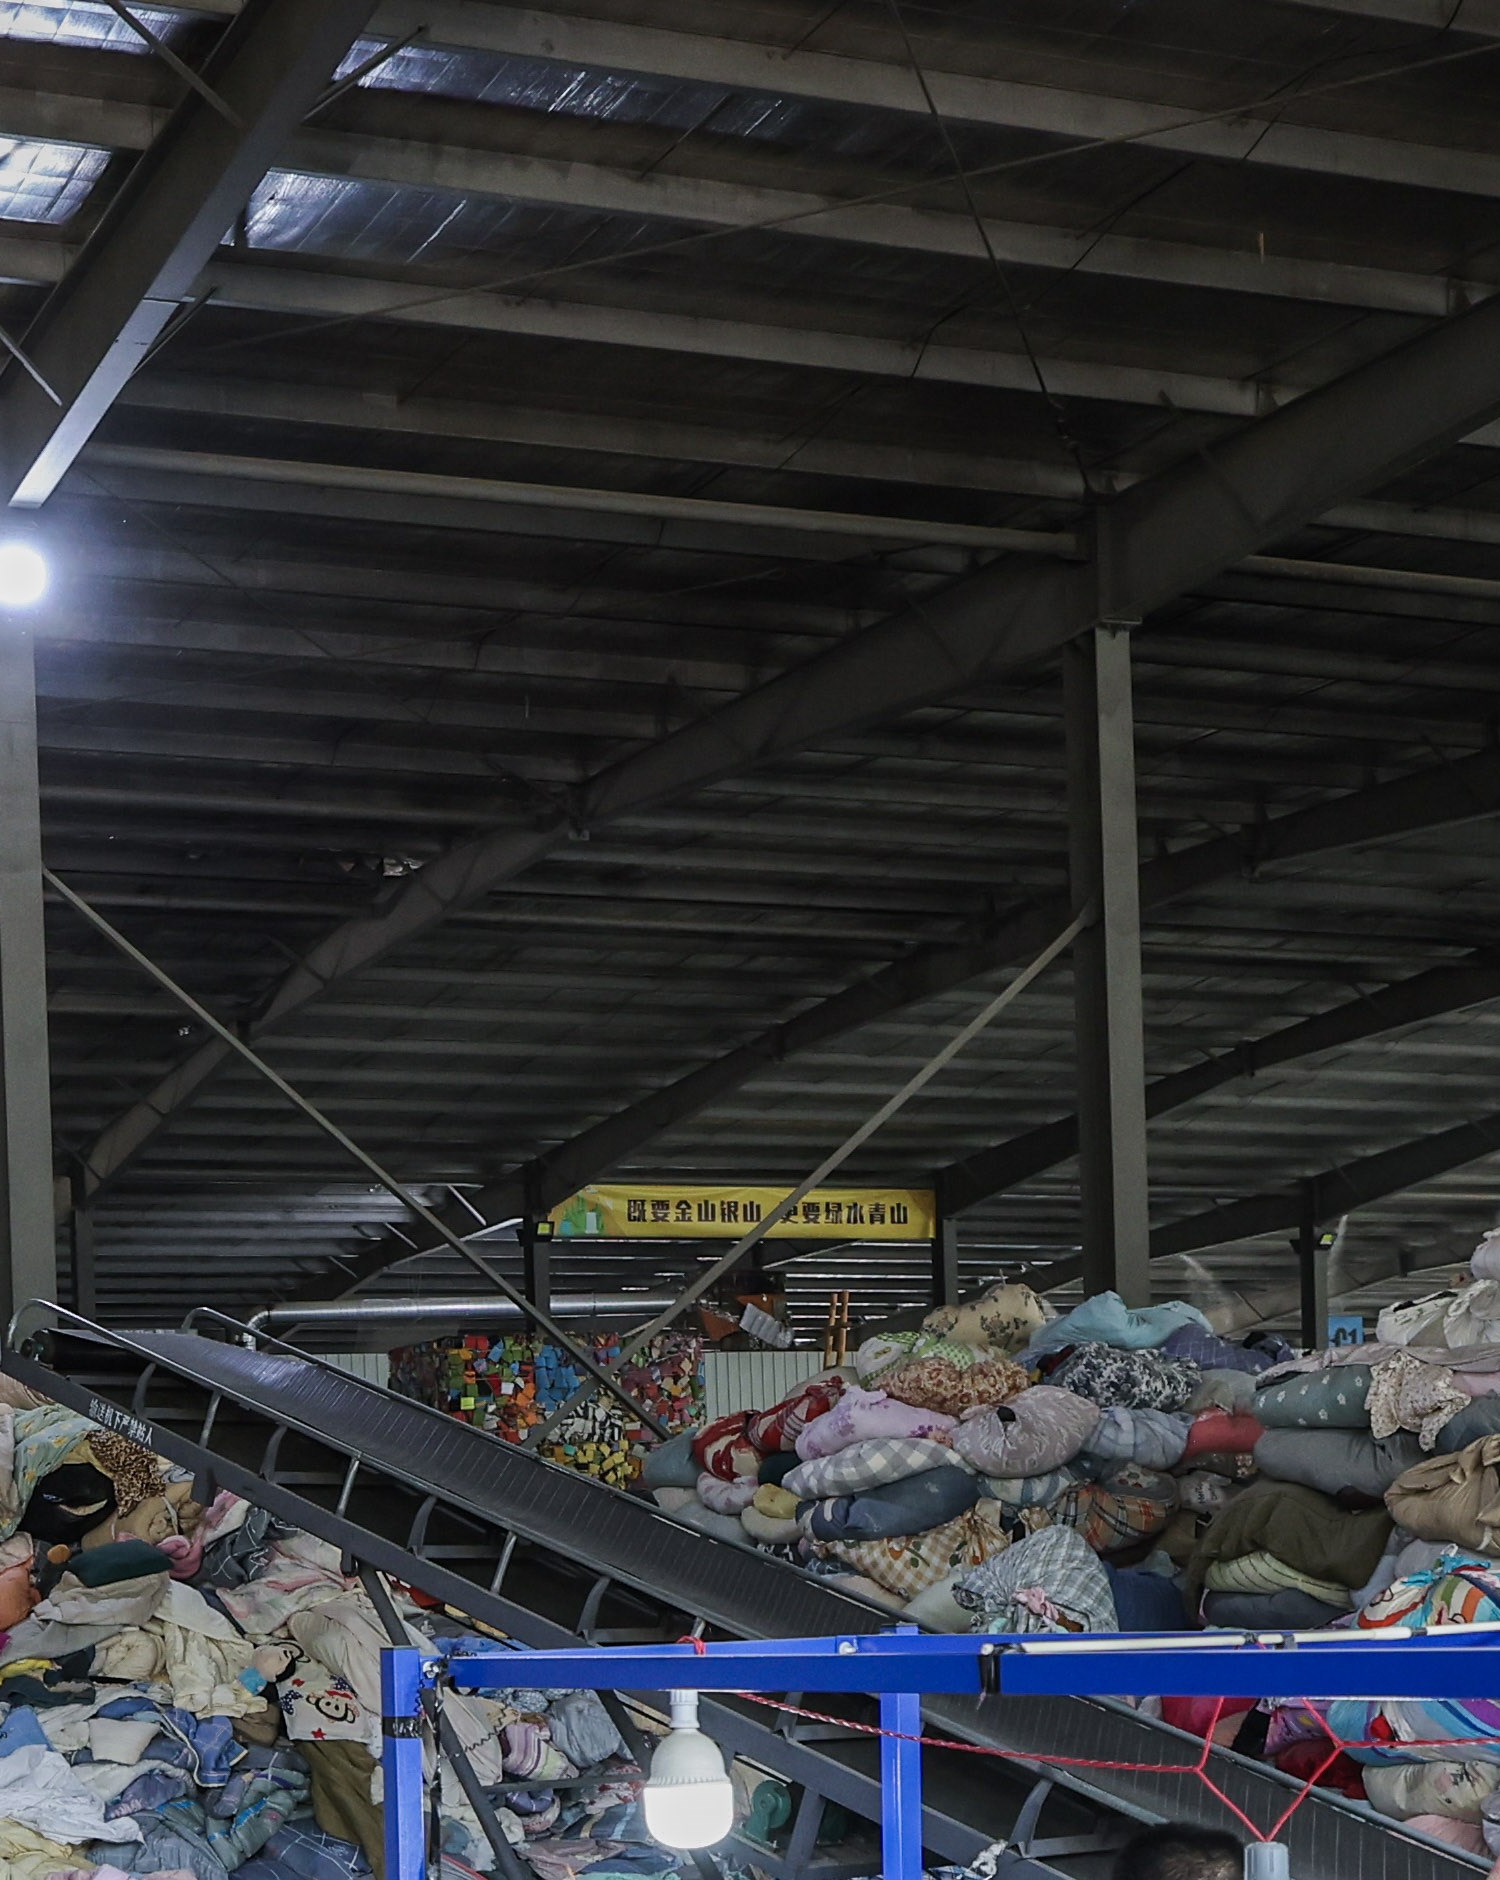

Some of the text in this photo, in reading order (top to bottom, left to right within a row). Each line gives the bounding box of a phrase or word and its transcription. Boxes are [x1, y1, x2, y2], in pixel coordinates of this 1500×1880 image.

[627, 1199, 908, 1225] 既要金山银山 更要绿水青山
